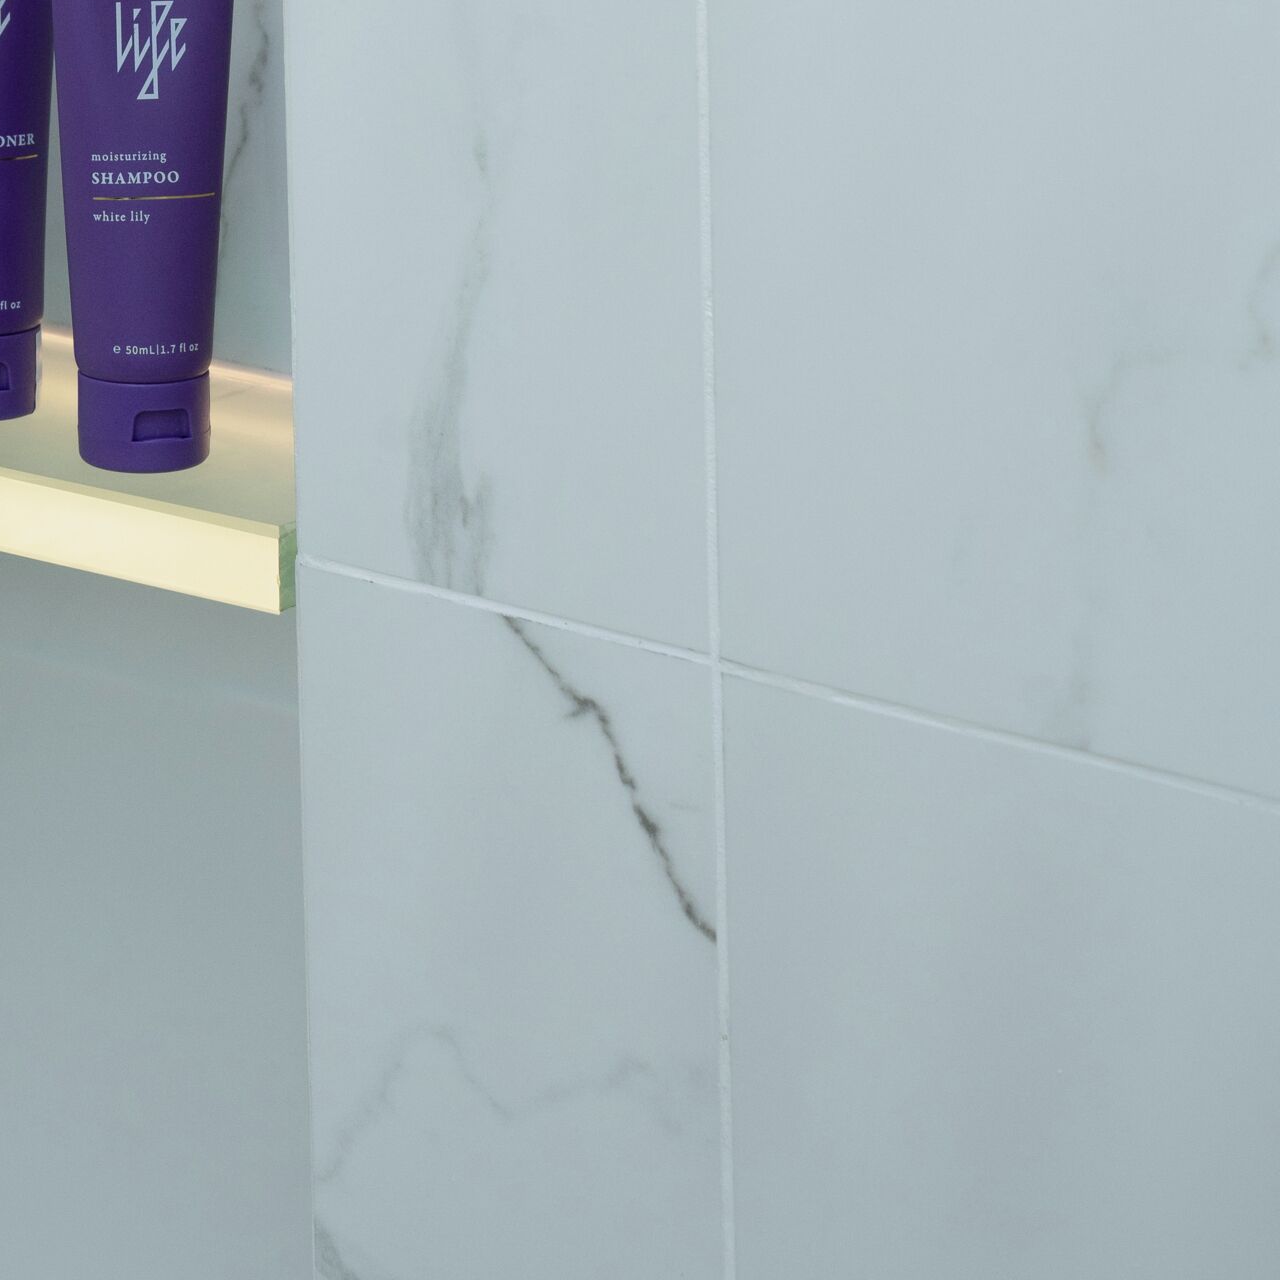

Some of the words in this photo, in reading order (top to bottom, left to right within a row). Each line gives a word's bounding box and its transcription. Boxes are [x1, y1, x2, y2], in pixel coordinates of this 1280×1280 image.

[91, 150, 167, 164] moisturizing
[91, 170, 180, 185] SHAMPOO
[93, 210, 127, 222] white
[130, 210, 151, 225] lily
[0, 300, 8, 311] fl
[10, 300, 22, 310] oz
[179, 342, 187, 353] fl
[188, 342, 199, 352] oz
